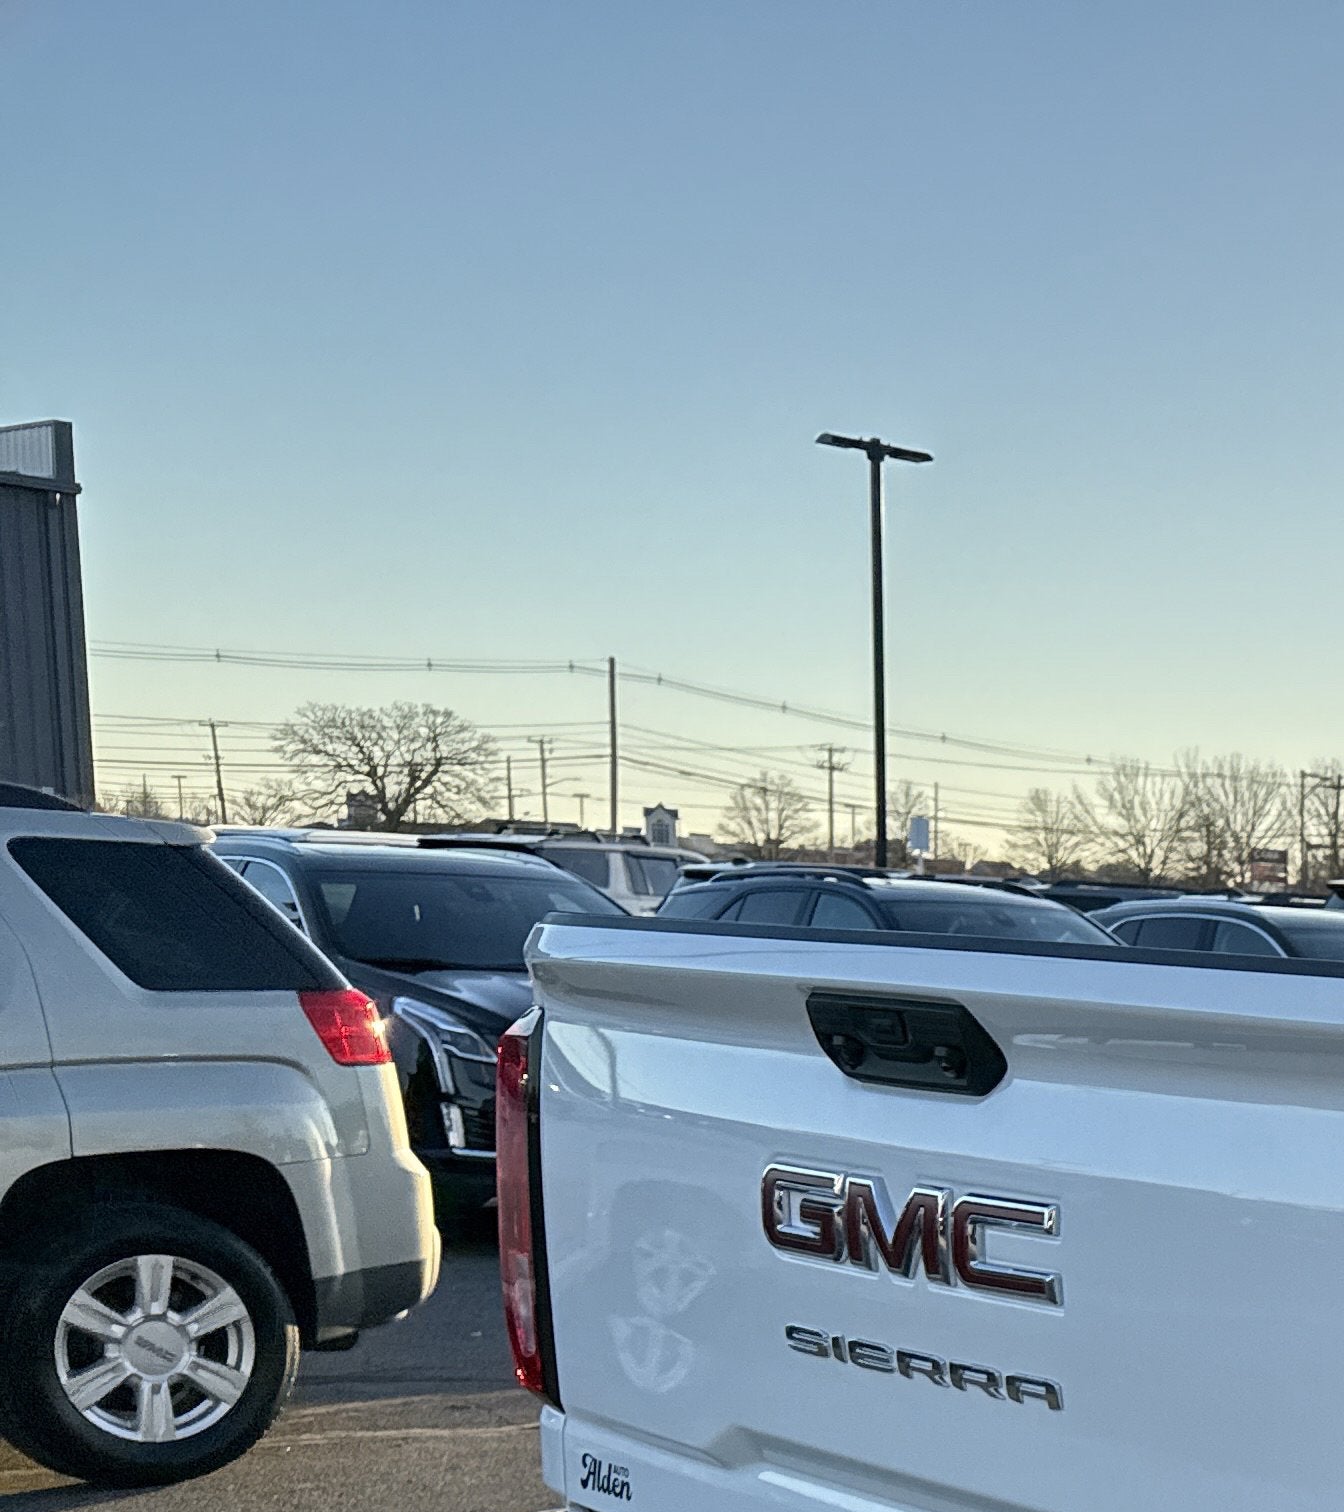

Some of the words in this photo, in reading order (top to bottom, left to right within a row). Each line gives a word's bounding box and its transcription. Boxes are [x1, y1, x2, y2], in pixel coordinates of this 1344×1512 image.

[761, 1163, 1065, 1307] GMC
[134, 1335, 178, 1363] GMC
[785, 1323, 1064, 1411] SIERRA
[580, 1453, 632, 1501] Alden
[613, 1464, 630, 1479] AUTO
